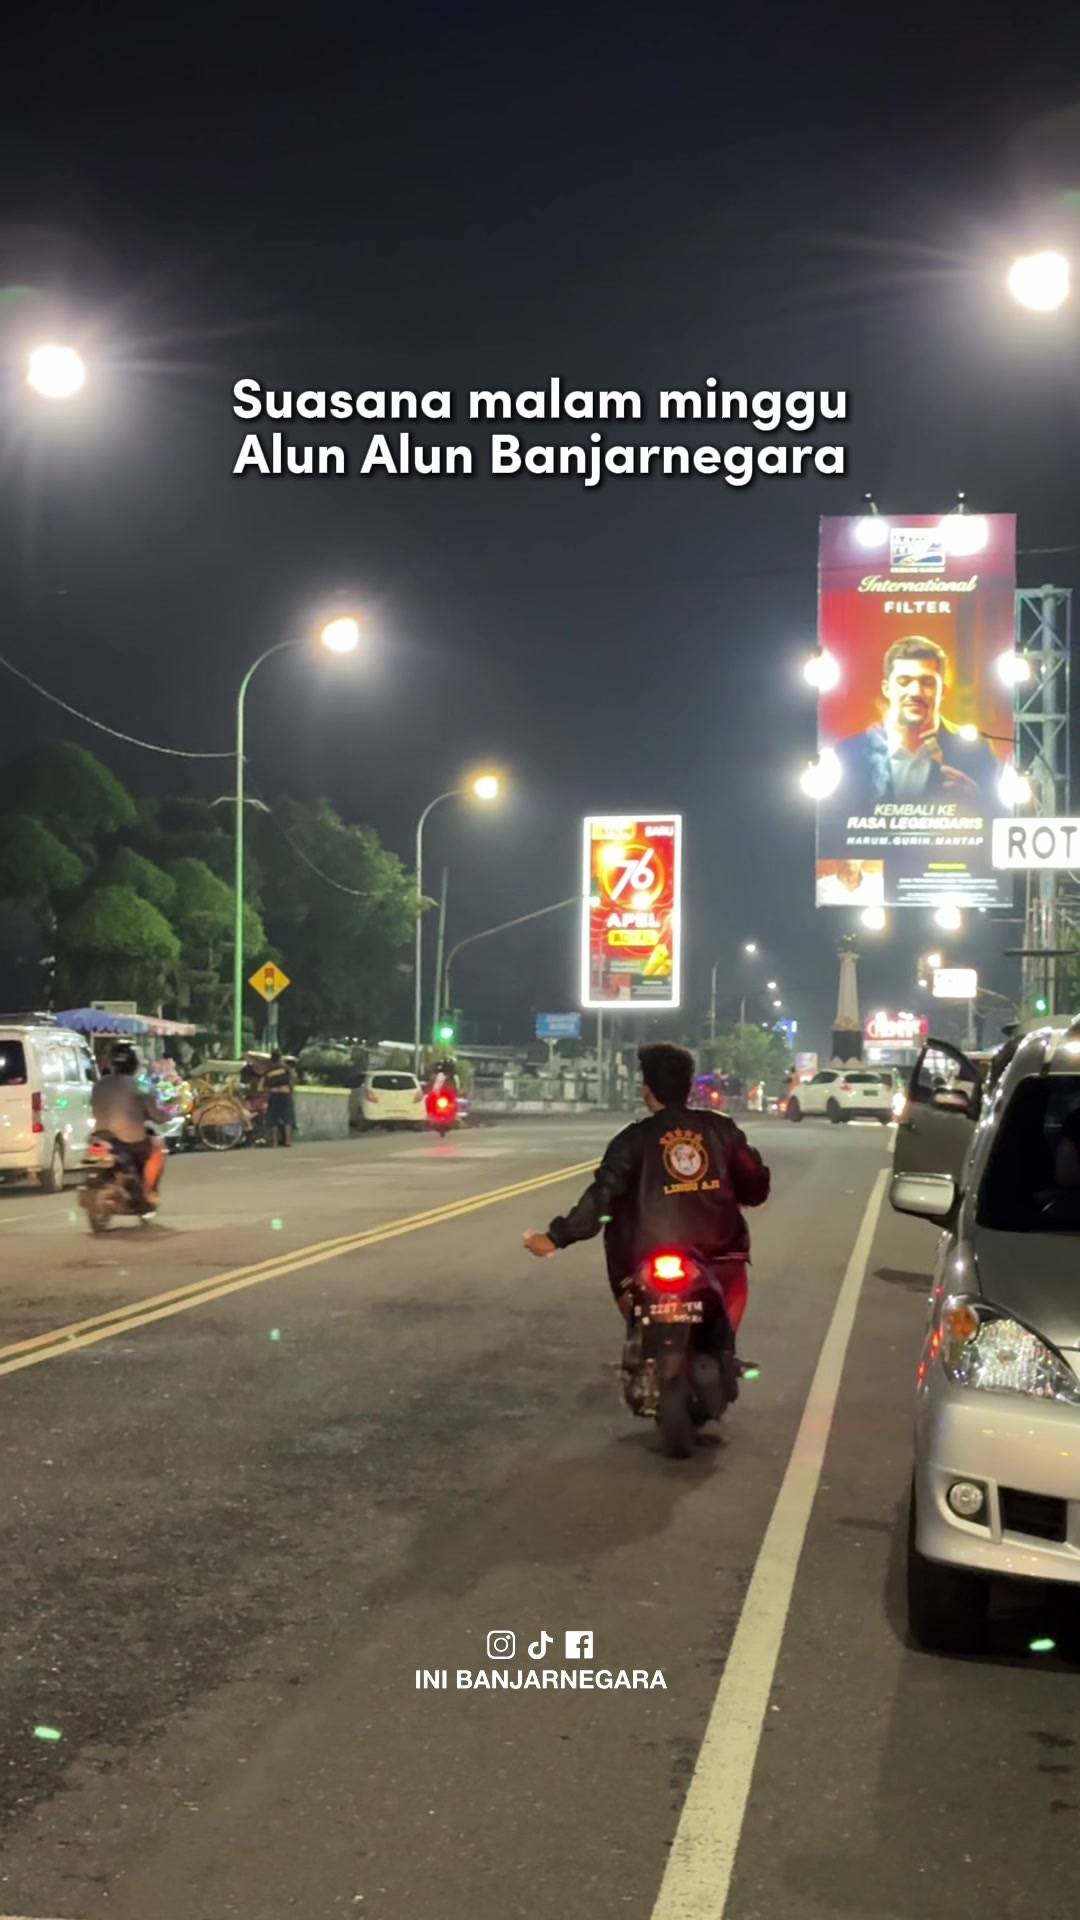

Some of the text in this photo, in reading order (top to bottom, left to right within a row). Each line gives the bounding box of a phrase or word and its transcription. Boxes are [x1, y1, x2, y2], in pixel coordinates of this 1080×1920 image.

[858, 574, 979, 593] International
[884, 601, 951, 614] FILTER
[874, 804, 957, 817] KEMBALI KE
[847, 817, 984, 830] RASA LEGENDARIS
[1008, 826, 1078, 859] ROT
[610, 848, 655, 902] 76
[607, 913, 660, 928] APEL
